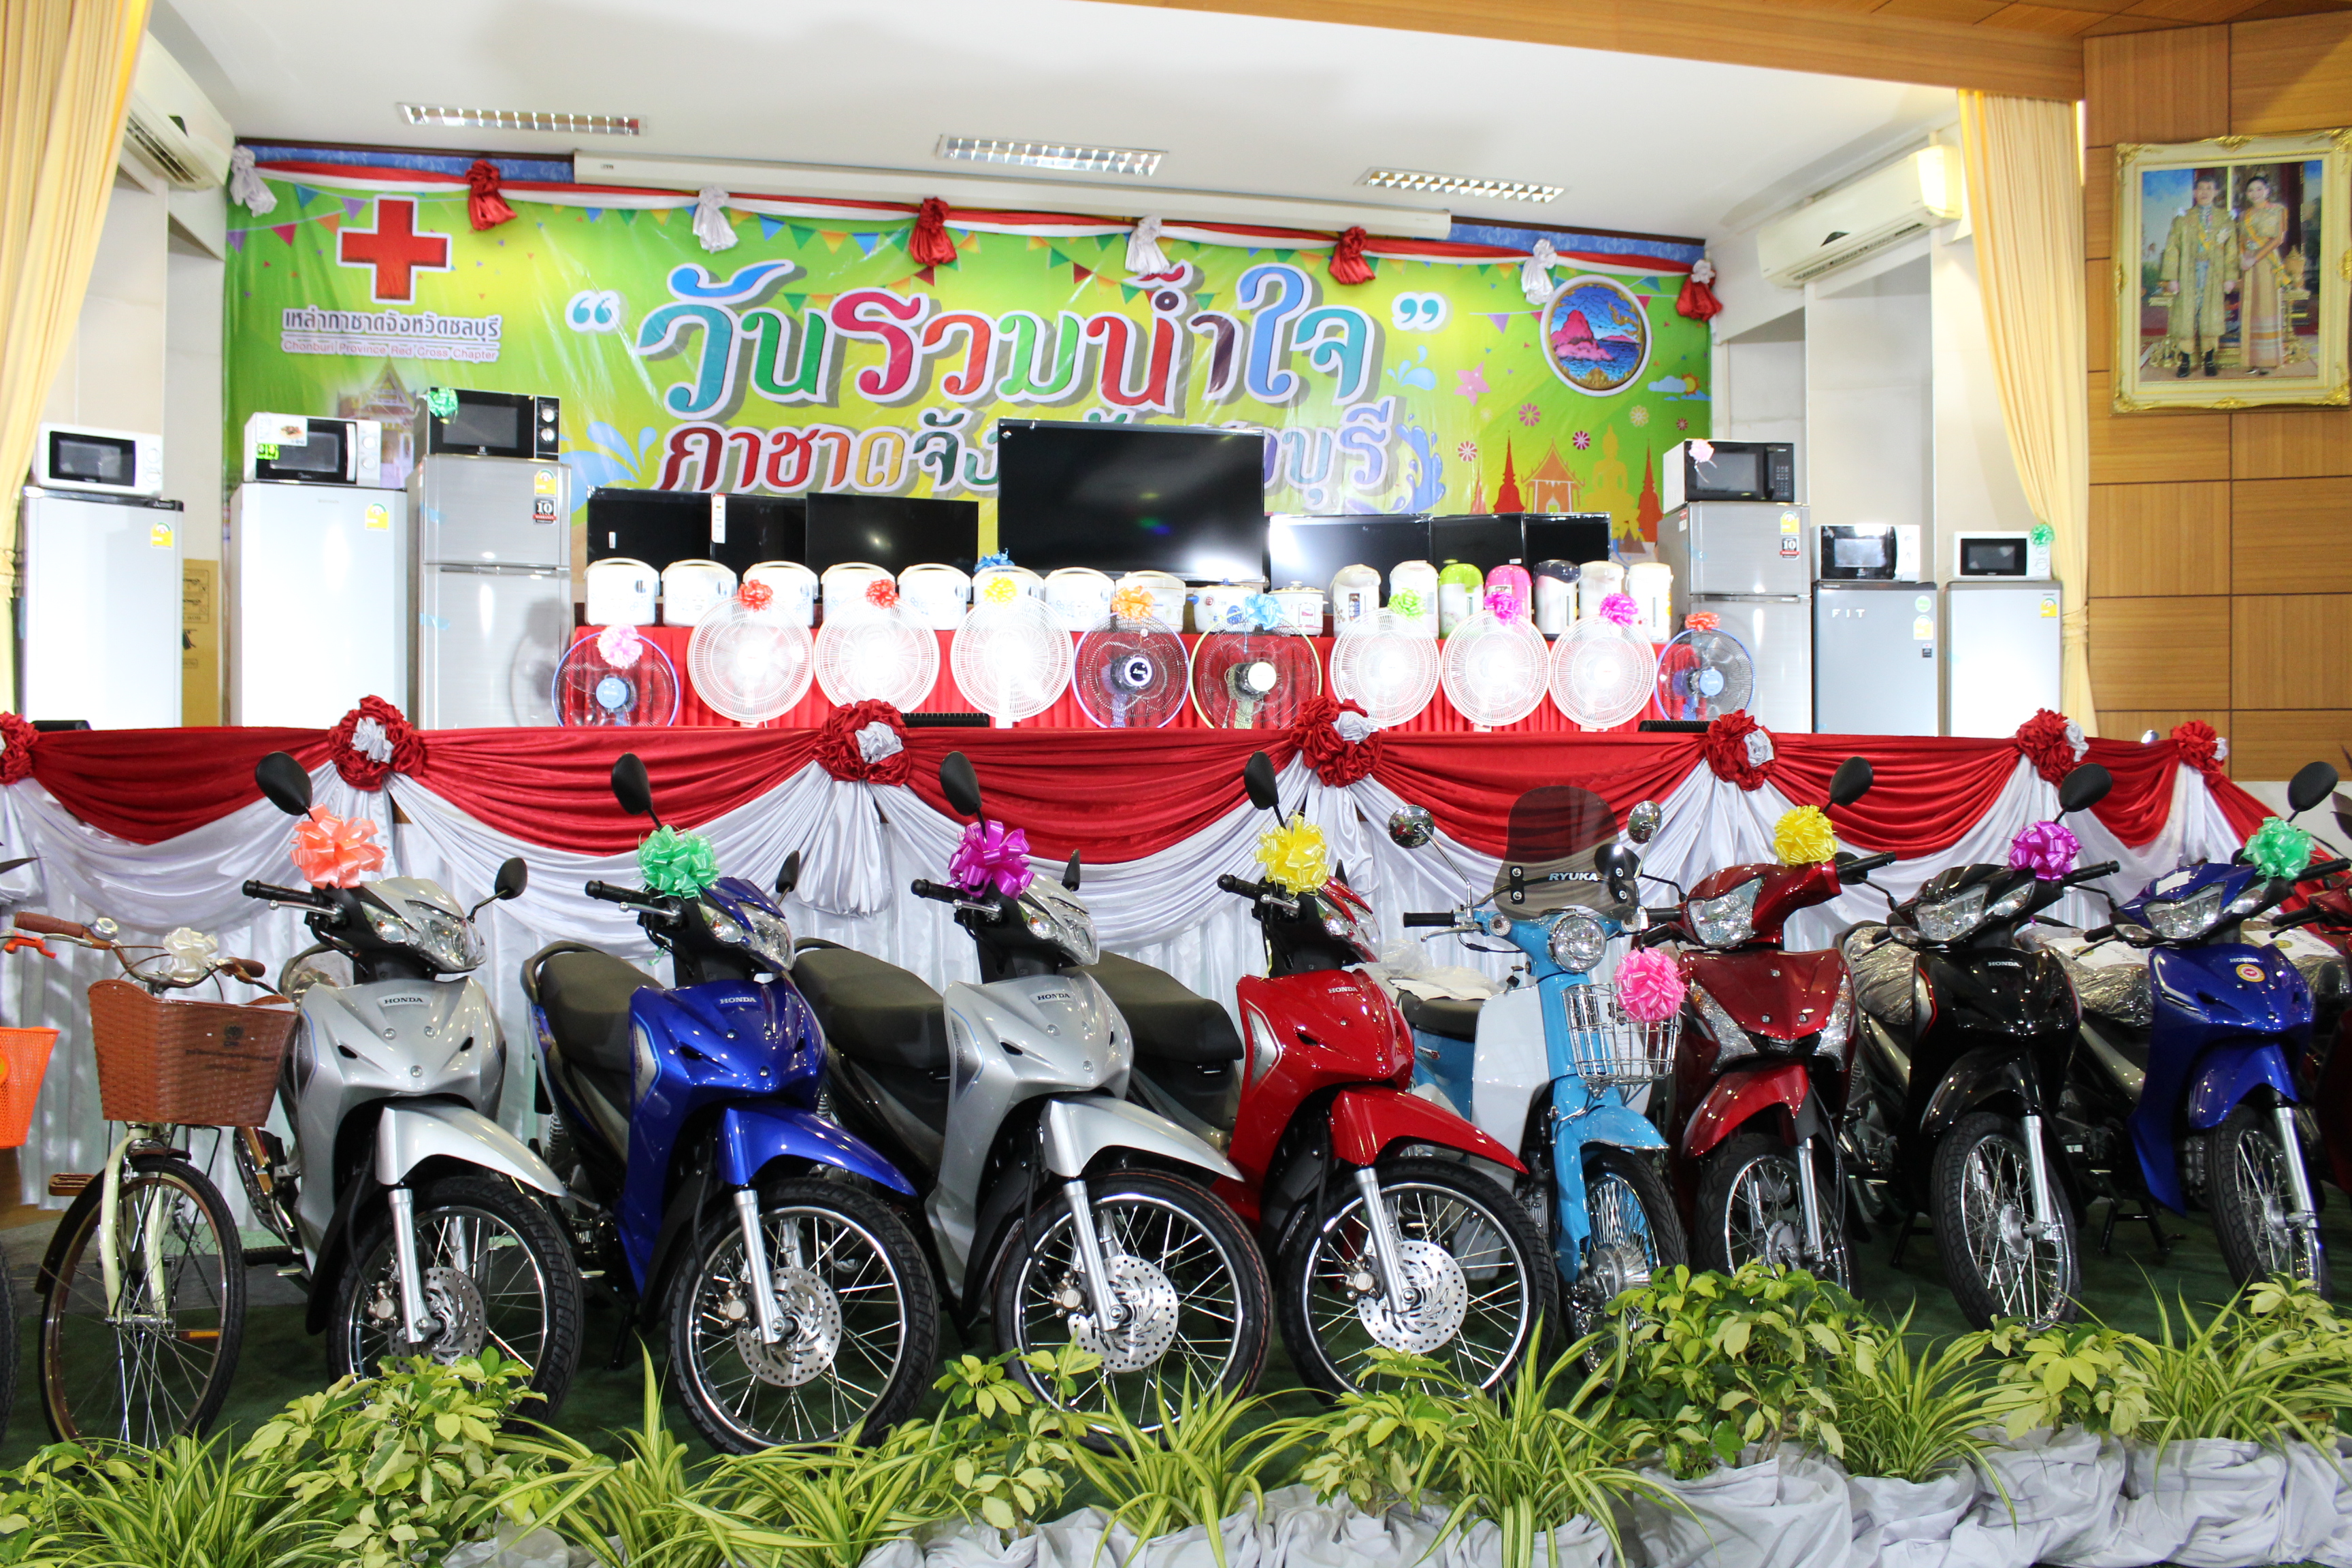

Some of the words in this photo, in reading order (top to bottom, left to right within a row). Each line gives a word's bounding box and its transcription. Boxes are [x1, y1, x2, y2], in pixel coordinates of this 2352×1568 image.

[285, 306, 500, 342] เหล่ากาชาดจังหวัดชลบุรี
[284, 341, 334, 353] Chonburi
[340, 342, 386, 355] Province
[391, 346, 412, 355] Red
[417, 346, 448, 357] Cross
[453, 348, 496, 361] Chapter
[537, 502, 553, 514] 10
[1782, 540, 1797, 550] 10
[1831, 608, 1865, 618] FIT
[1548, 871, 1599, 882] RYUKA
[1327, 985, 1358, 994] HONDA
[384, 996, 425, 1005] HONDA
[720, 996, 757, 1004] HONDA
[1037, 992, 1071, 1002] HONDA
